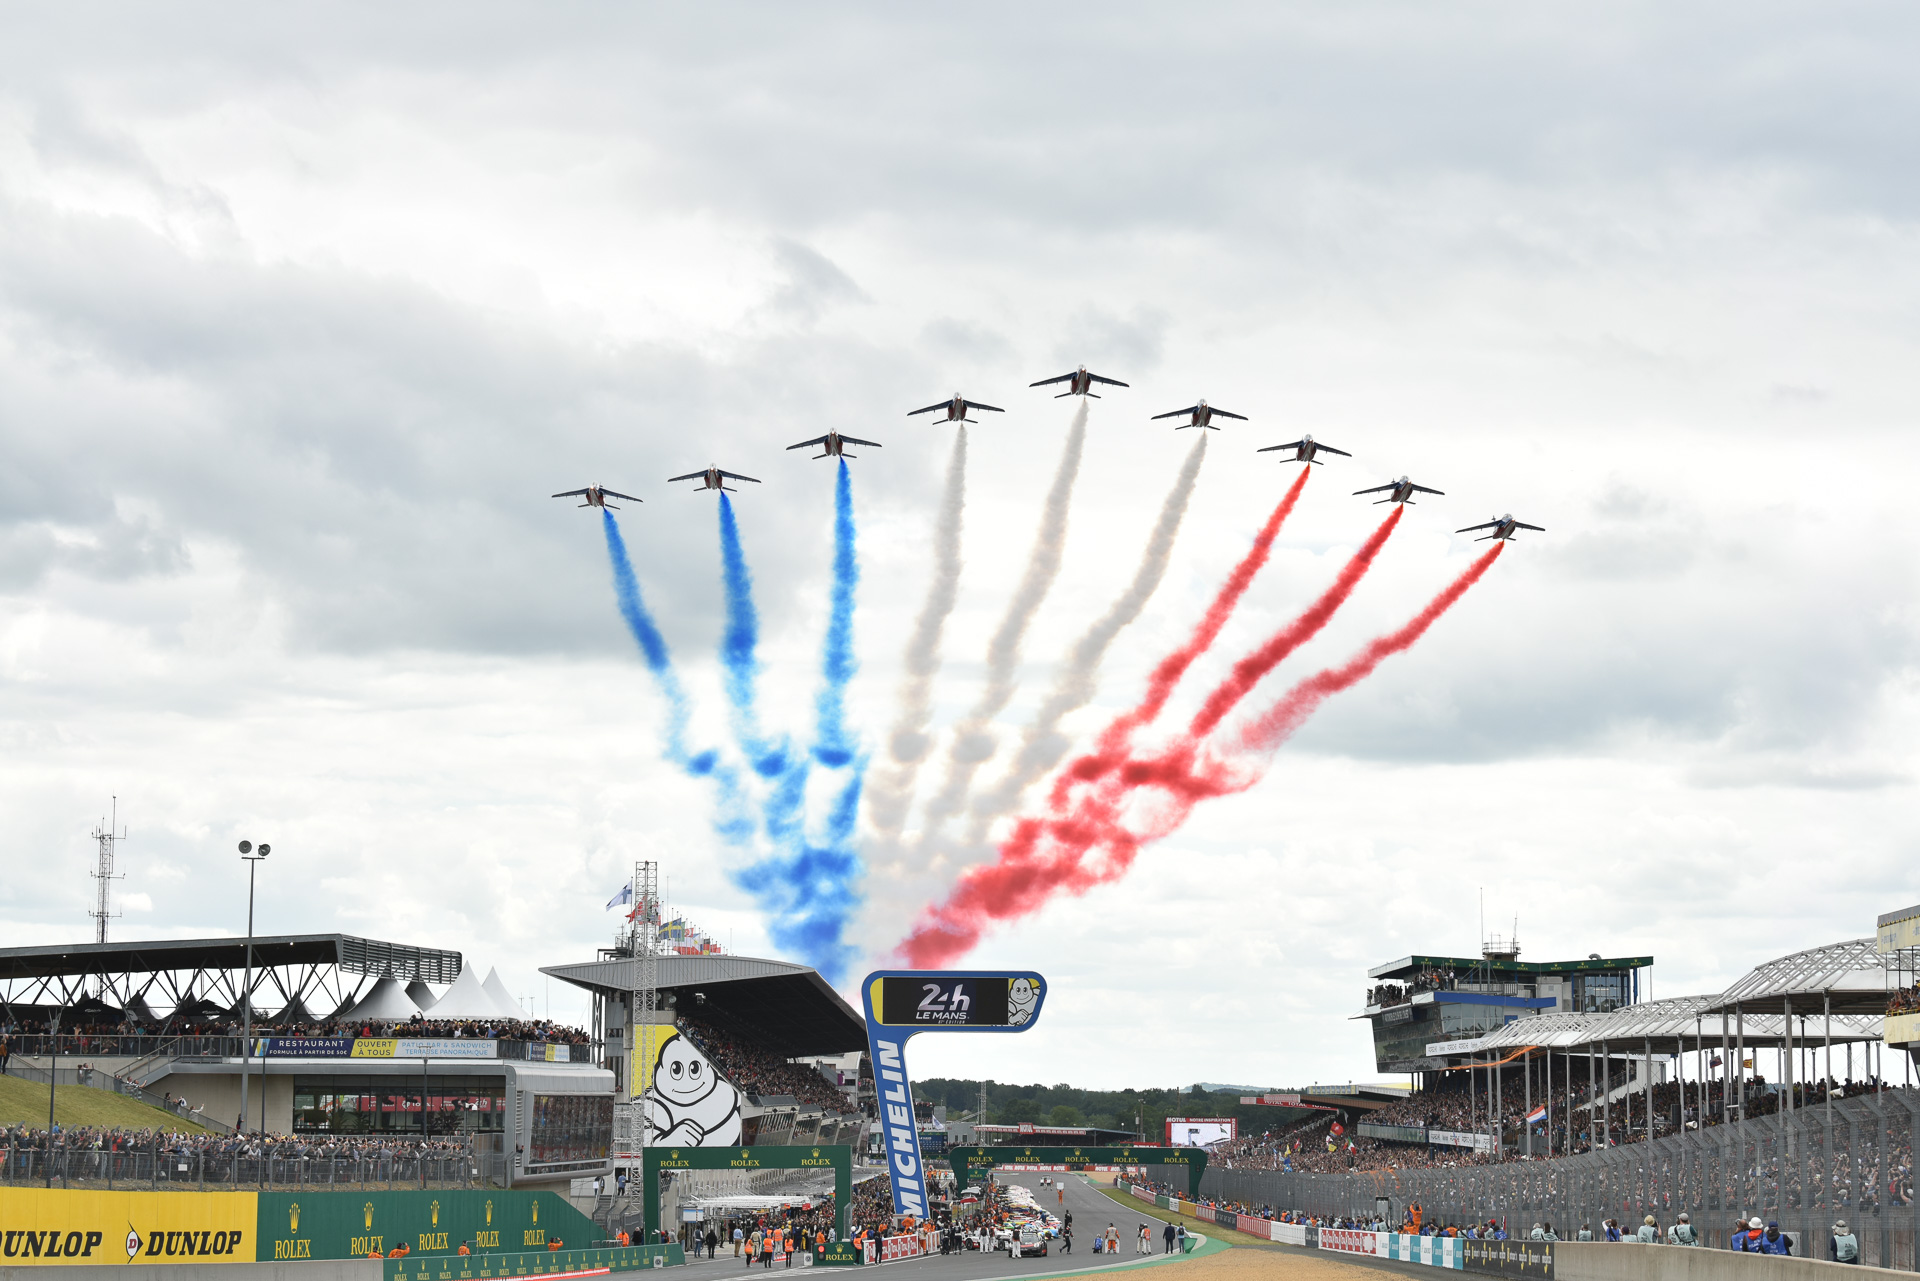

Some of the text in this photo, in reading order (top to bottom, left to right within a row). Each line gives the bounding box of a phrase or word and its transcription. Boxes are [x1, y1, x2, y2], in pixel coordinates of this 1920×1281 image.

[918, 984, 970, 1010] 24h
[877, 1040, 923, 1222] MICHELIN
[0, 1231, 102, 1257] UNLOP
[145, 1231, 242, 1256] DUNLOP
[350, 1236, 383, 1255] ROLEX
[419, 1233, 448, 1250] ROLEX
[476, 1231, 499, 1248] ROLEX
[524, 1229, 545, 1246] ROLEX
[274, 1240, 311, 1259] ROLEX
